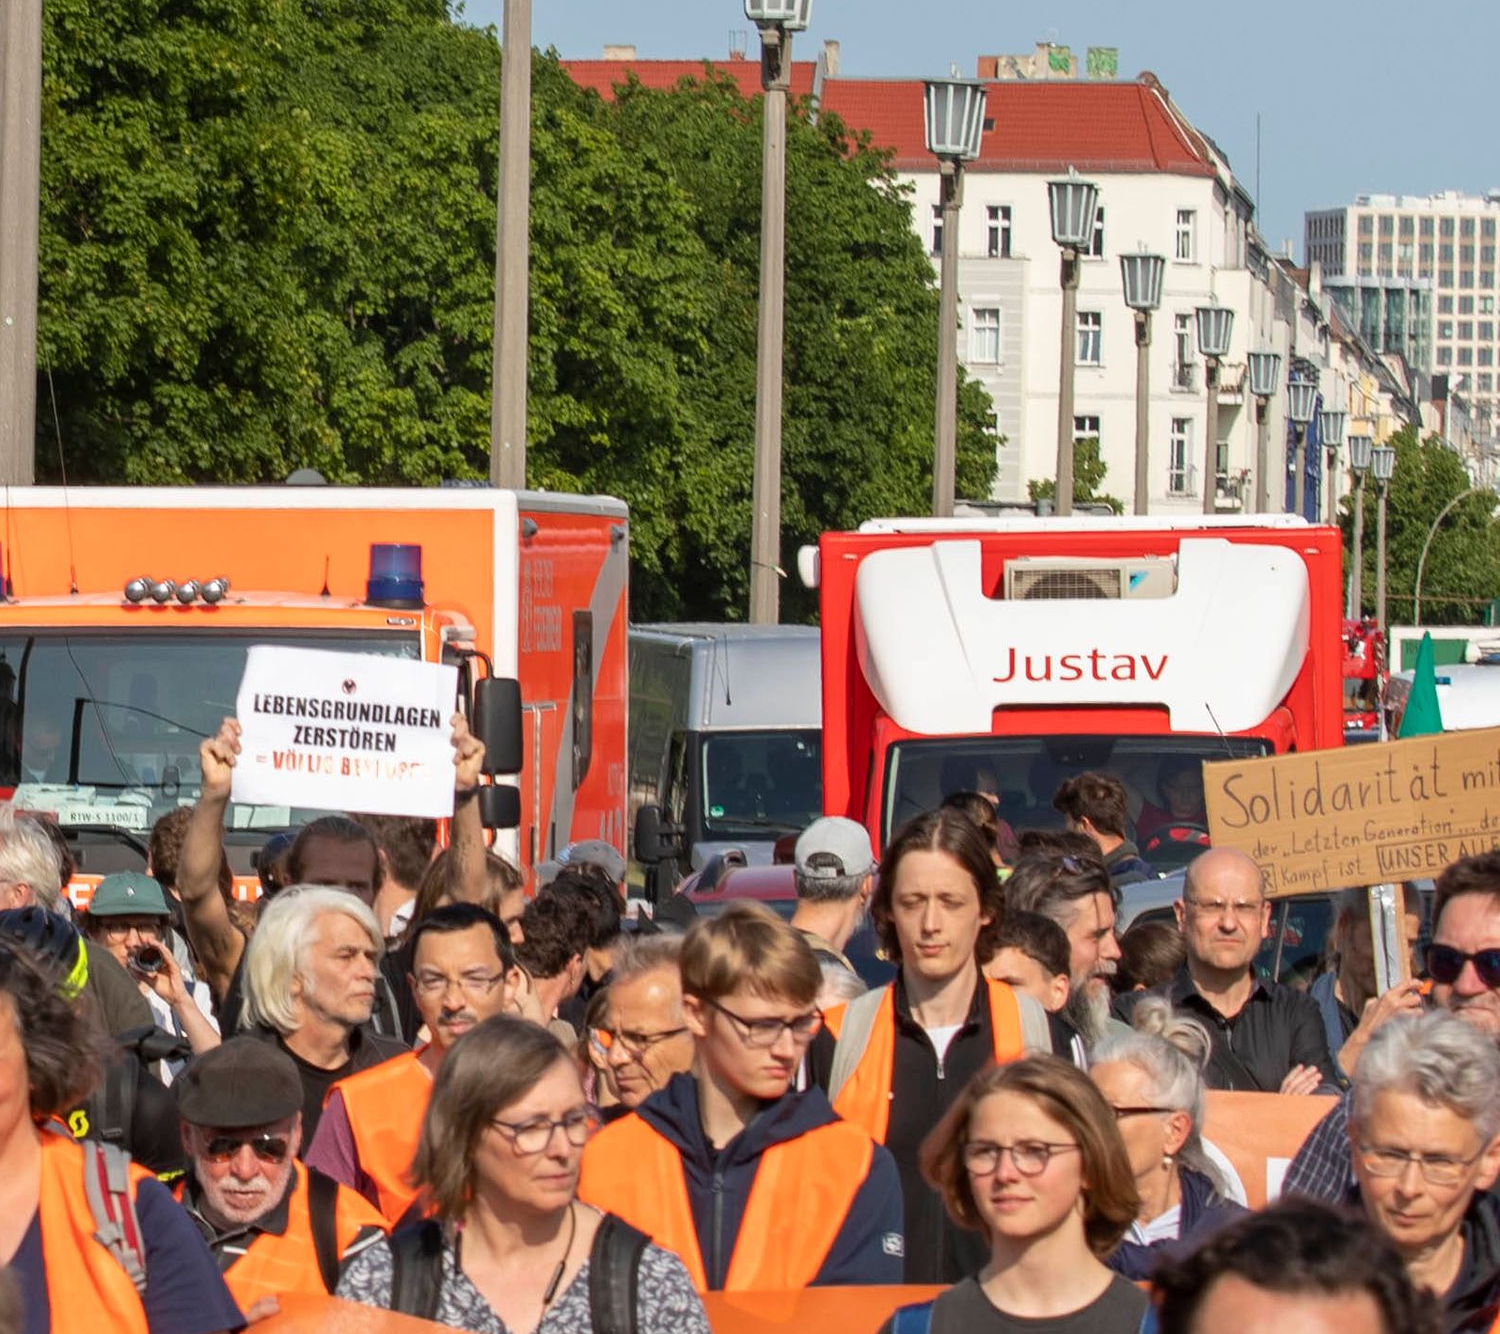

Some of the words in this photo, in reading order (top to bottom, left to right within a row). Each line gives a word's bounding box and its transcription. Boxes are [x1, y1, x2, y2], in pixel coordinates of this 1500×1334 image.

[993, 648, 1168, 682] Justav
[253, 694, 441, 728] LEBENSGRUNDLAGEN
[293, 725, 396, 752] ZERSTÖREN
[1221, 746, 1447, 828] Solidarität
[1252, 840, 1278, 859] der
[1282, 860, 1330, 888] Kampf
[1337, 857, 1366, 876] ist
[1380, 845, 1448, 870] UNSER
